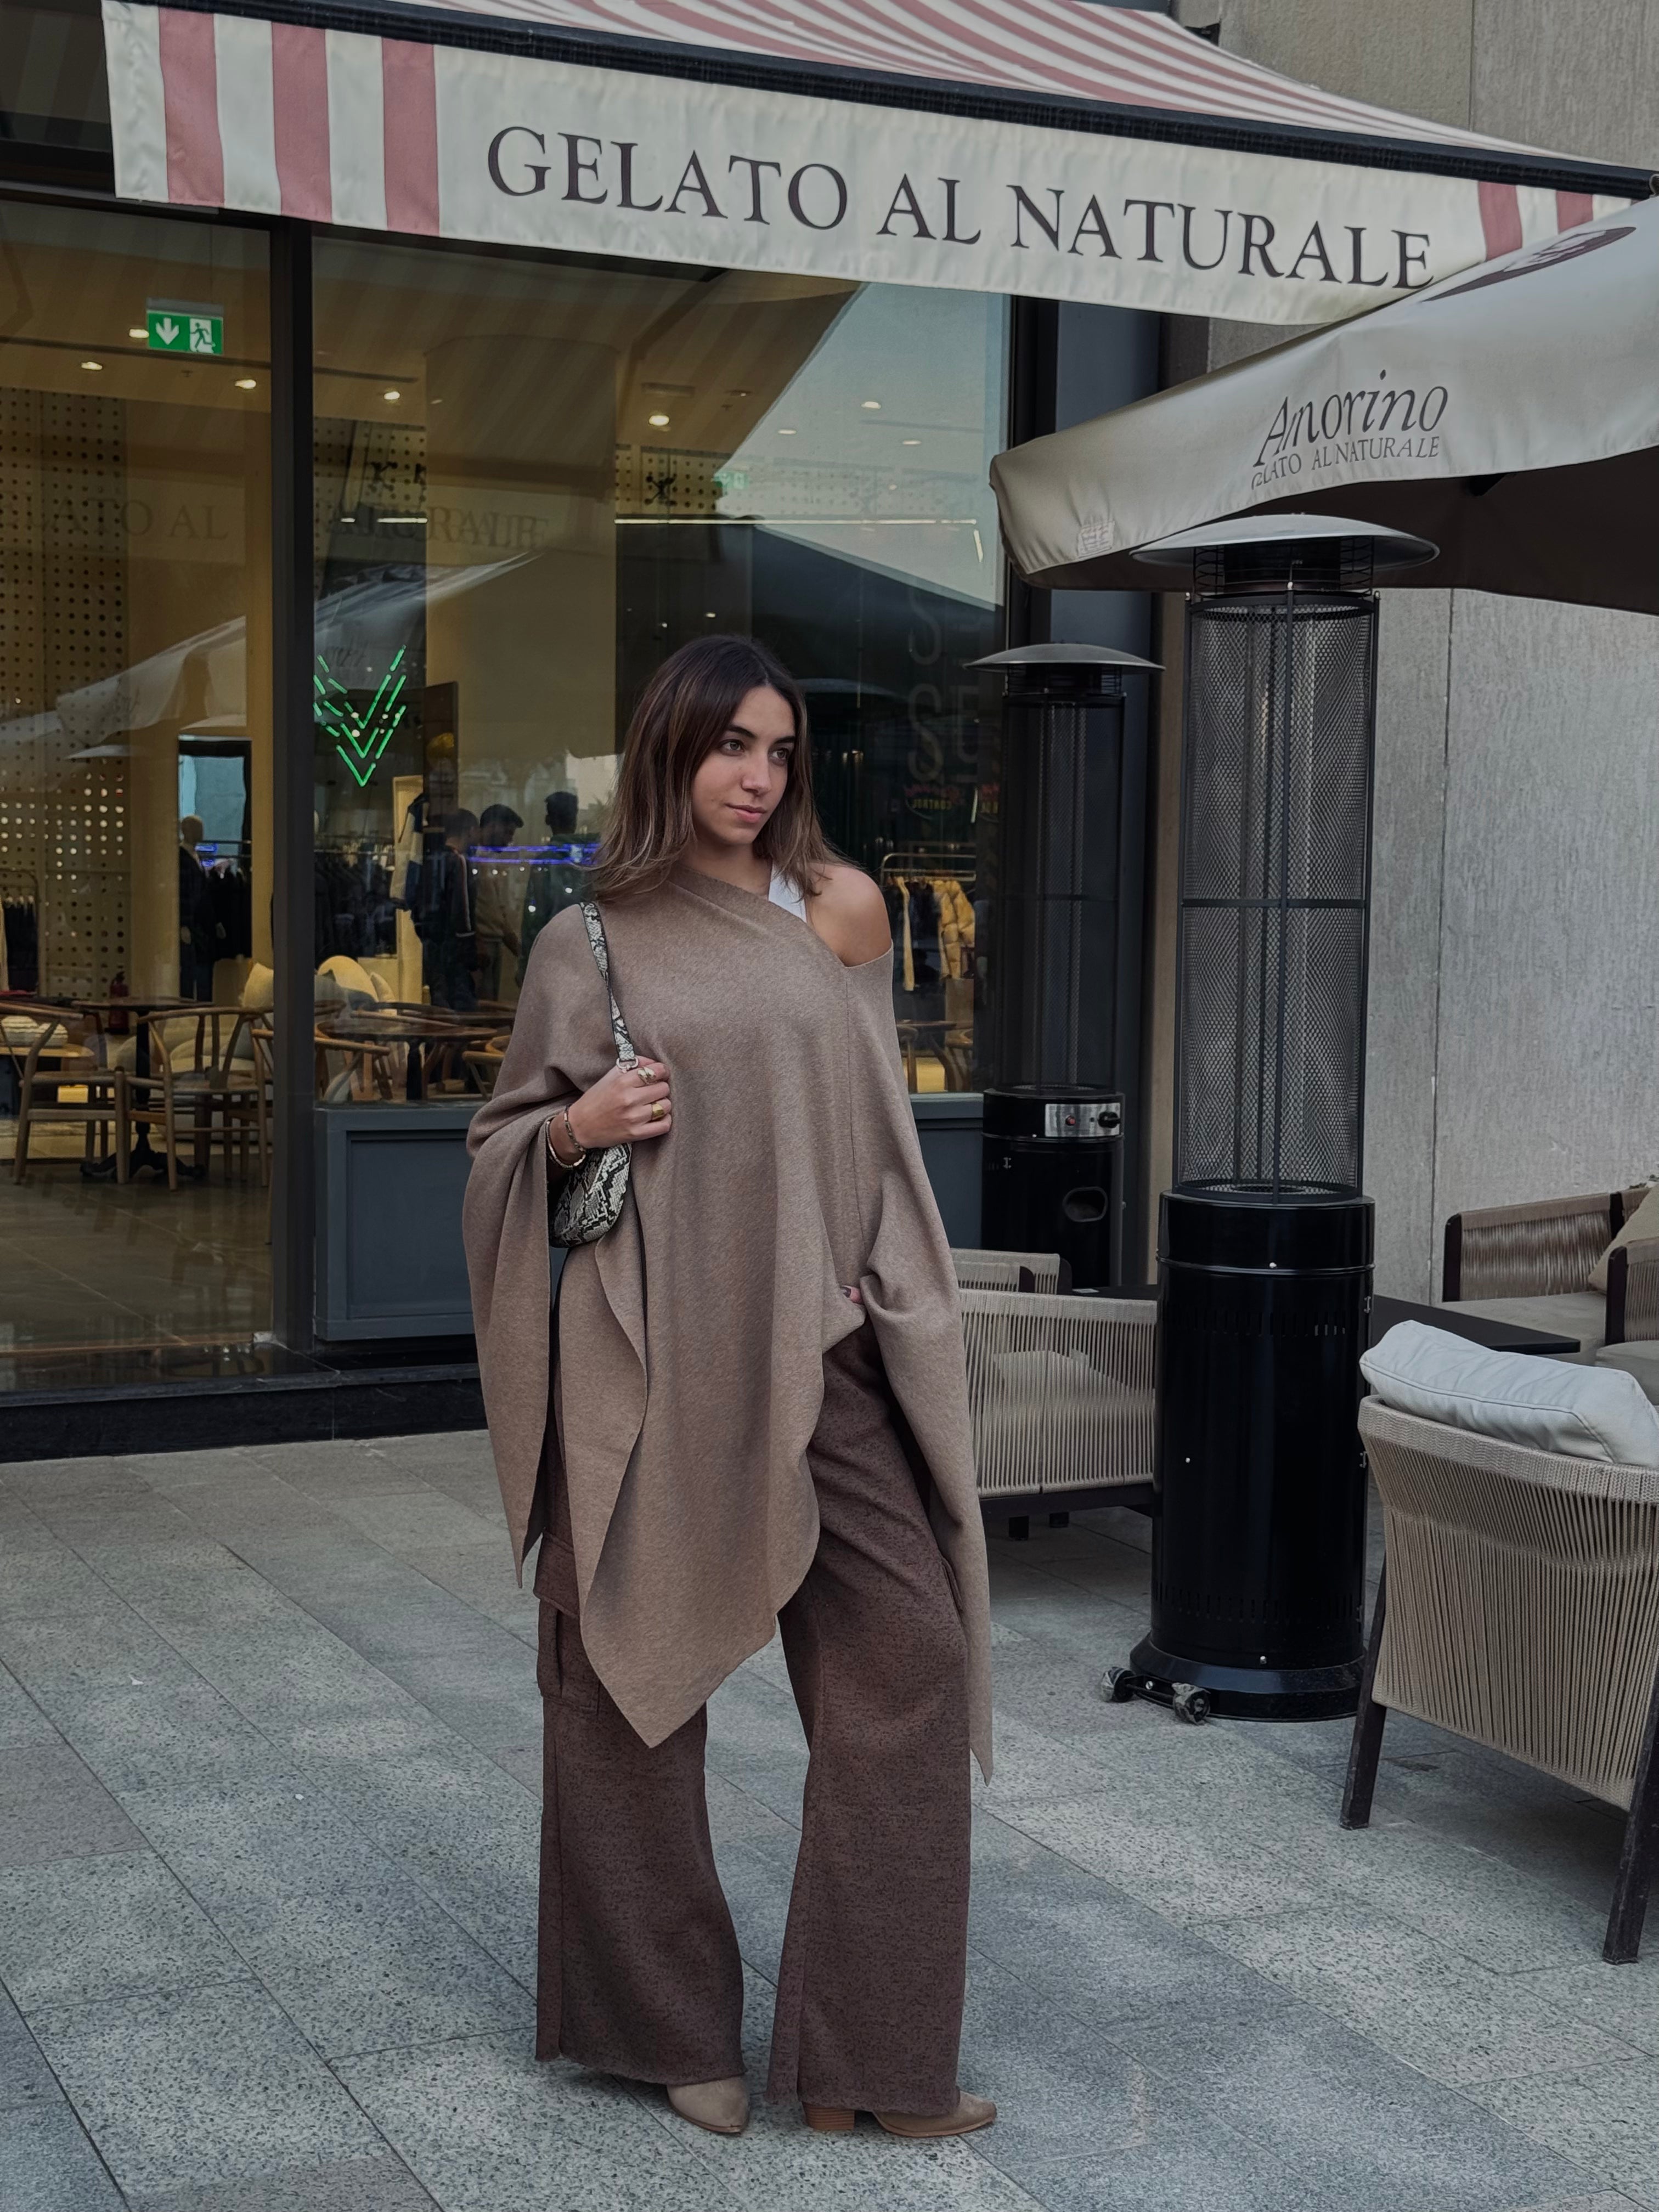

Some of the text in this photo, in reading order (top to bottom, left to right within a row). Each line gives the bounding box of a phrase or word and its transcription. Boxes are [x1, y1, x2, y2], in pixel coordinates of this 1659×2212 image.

[487, 126, 1434, 290] GELATO AL NATURALE
[1312, 445, 1332, 471] AL
[1335, 436, 1440, 464] NATURALE
